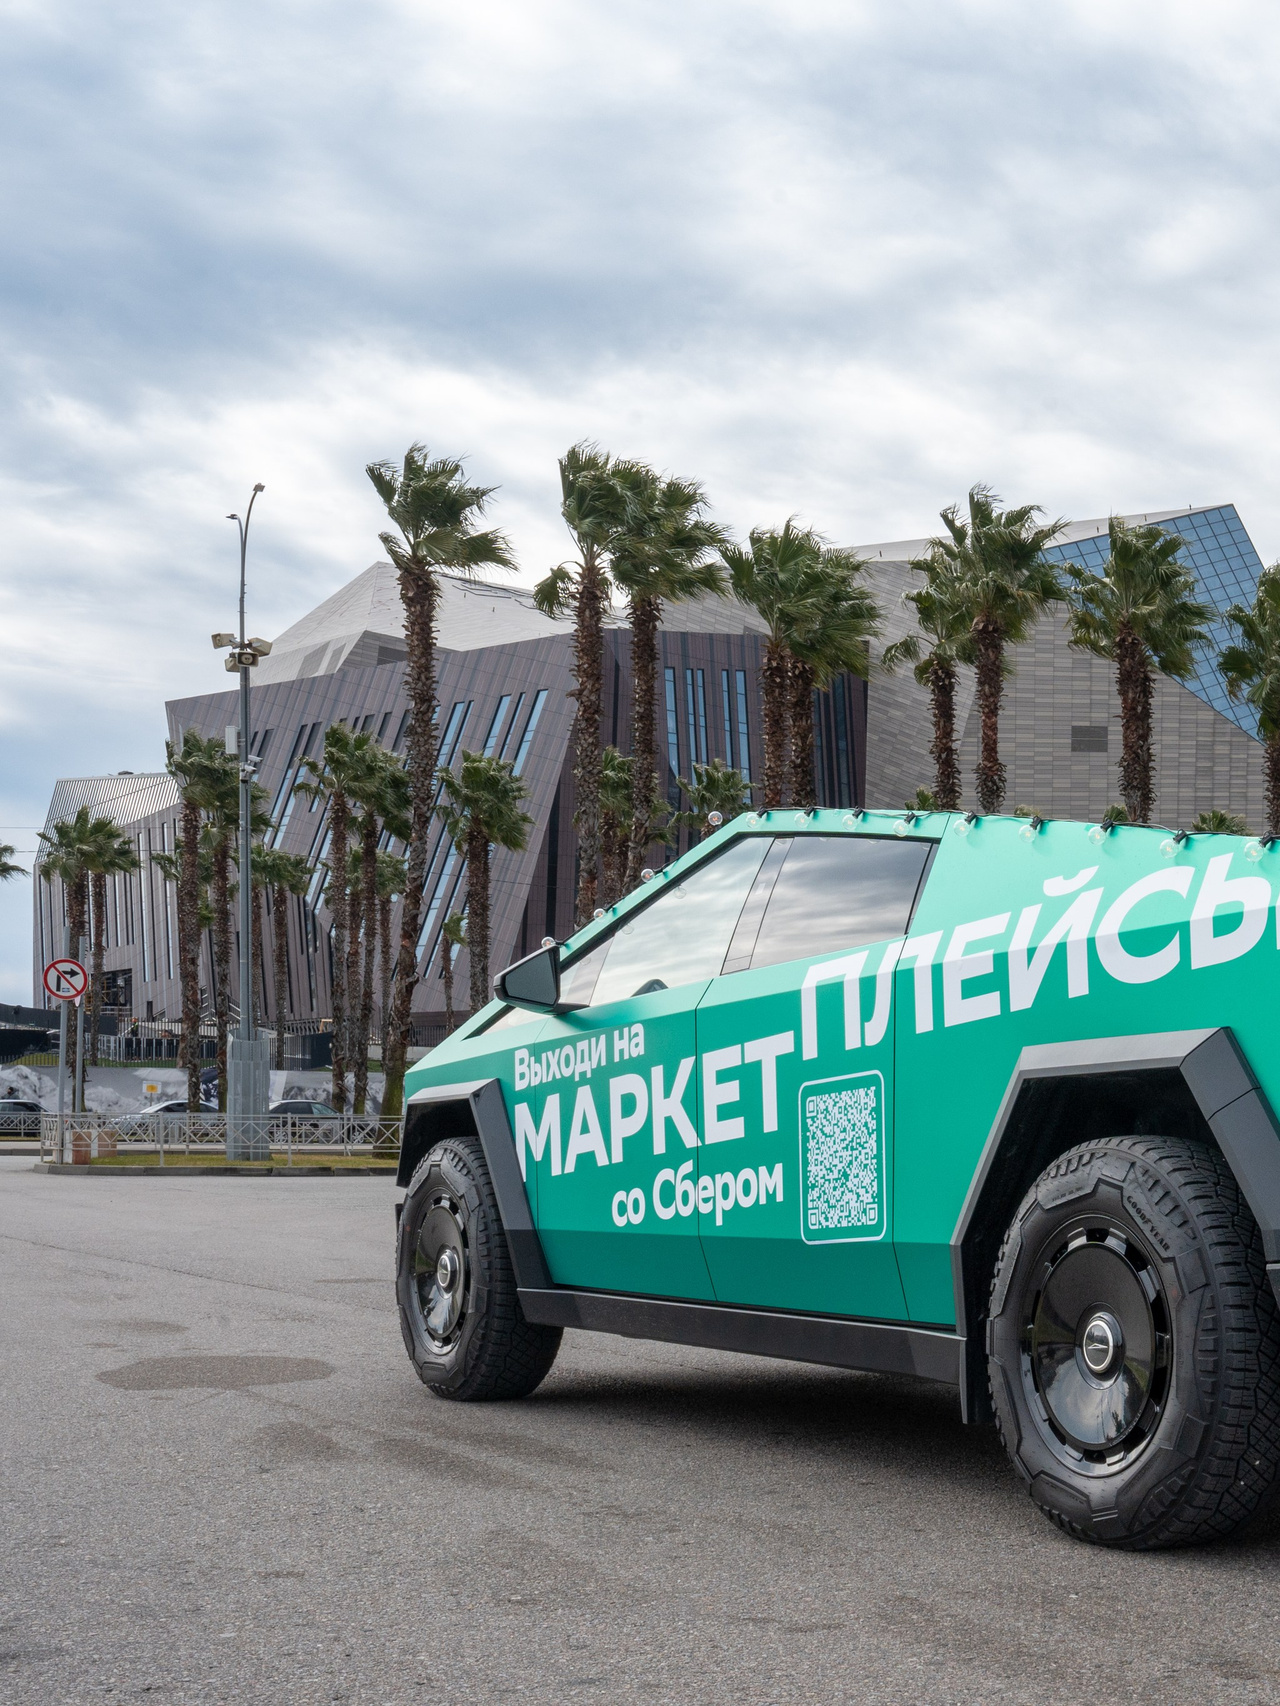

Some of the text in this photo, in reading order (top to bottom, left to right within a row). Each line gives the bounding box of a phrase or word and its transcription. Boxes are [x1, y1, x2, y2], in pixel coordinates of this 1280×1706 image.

[514, 1023, 645, 1091] Выходи на
[514, 1030, 795, 1182] МАРКЕТ
[611, 1159, 784, 1227] со Сбером
